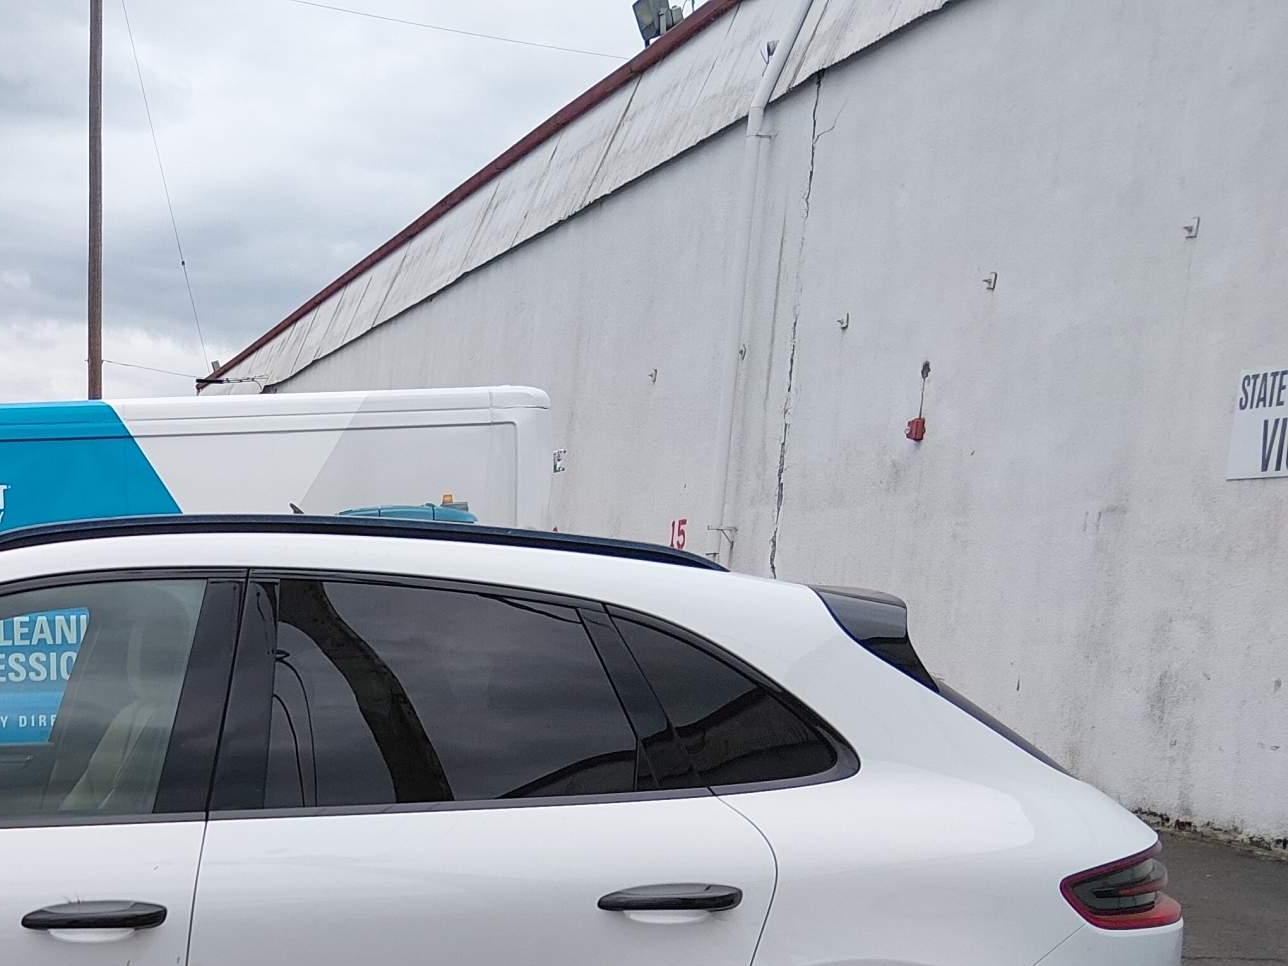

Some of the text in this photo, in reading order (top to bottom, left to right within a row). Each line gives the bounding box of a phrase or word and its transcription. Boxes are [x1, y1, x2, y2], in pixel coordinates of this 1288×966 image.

[1239, 369, 1288, 410] STATE
[1260, 417, 1288, 472] VI
[670, 518, 687, 549] 15
